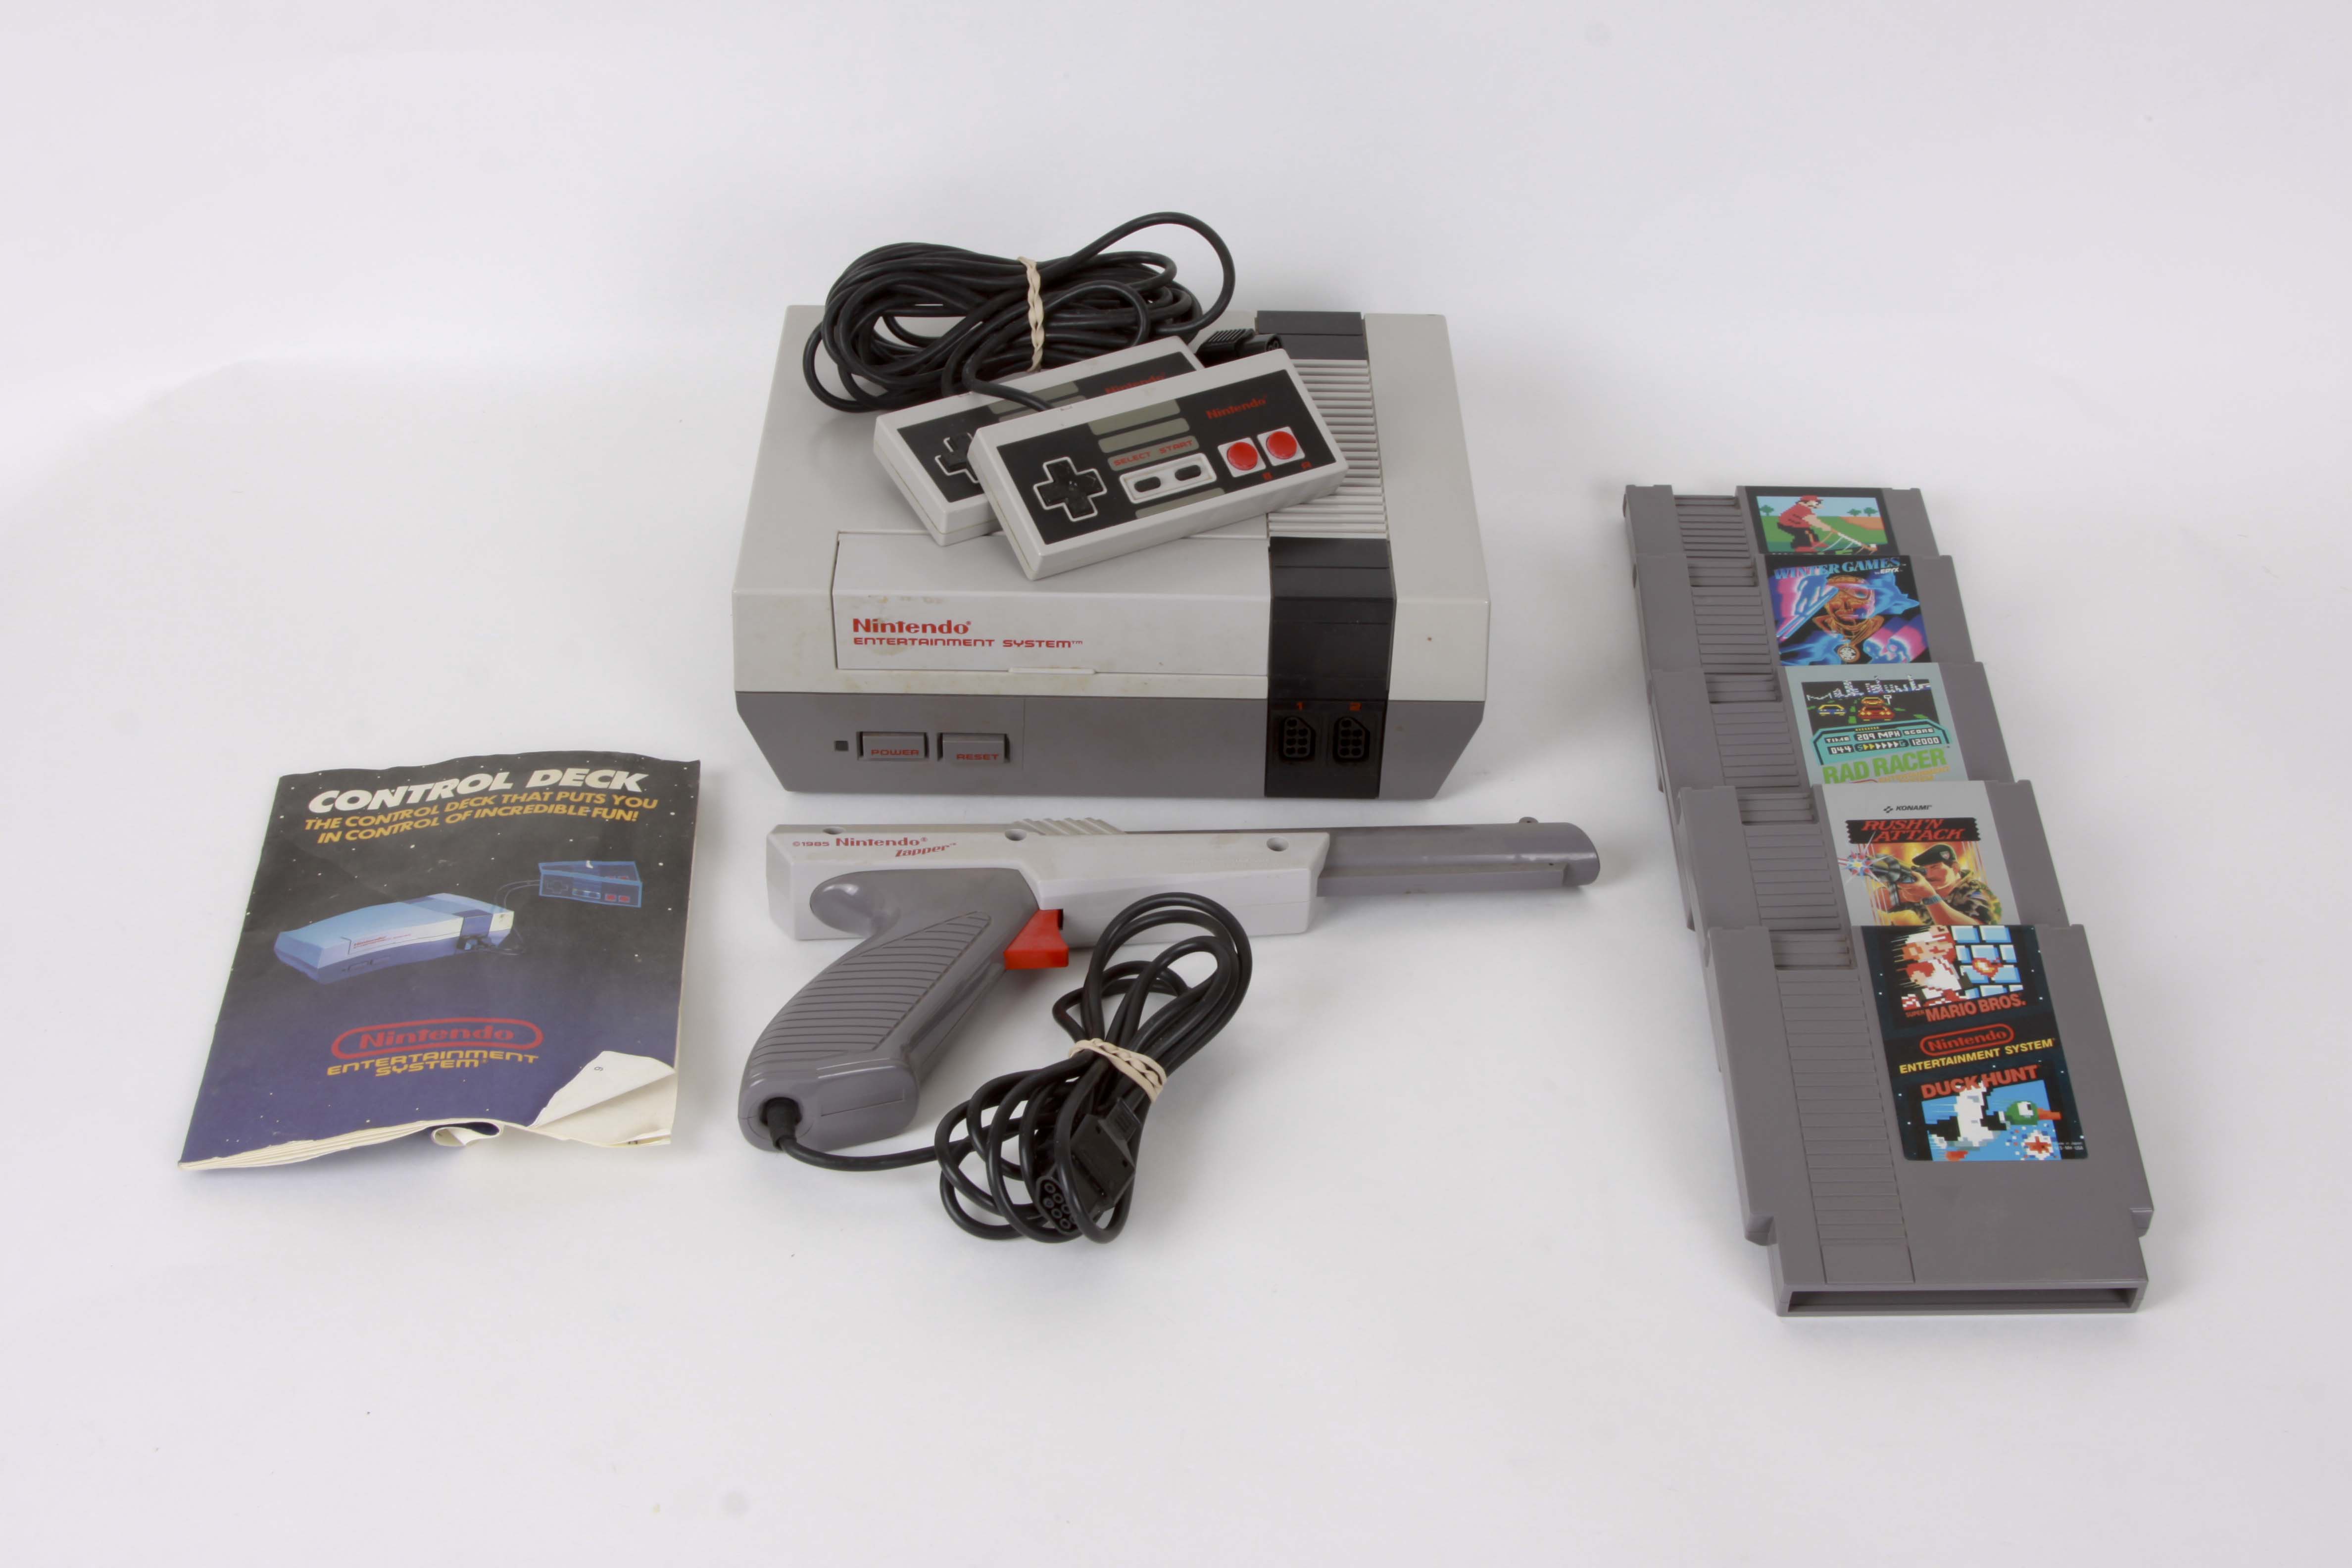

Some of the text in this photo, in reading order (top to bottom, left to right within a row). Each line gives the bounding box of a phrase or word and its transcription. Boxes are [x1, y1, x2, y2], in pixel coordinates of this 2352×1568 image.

[1114, 440, 1192, 466] SELECT START
[1774, 557, 1901, 580] WINTER GAMES
[853, 637, 995, 647] ENTERTAINMENT
[1831, 745, 1852, 754] 044
[1911, 736, 1940, 746] 12000
[1857, 733, 1876, 741] 209
[1877, 730, 1901, 738] MPH
[1821, 760, 1870, 784] RAD
[1872, 747, 1948, 777] RACER
[308, 768, 649, 814] CONTROL DECK
[305, 791, 659, 831] THE CONTROL DECK THAT PUTS YOU
[317, 803, 639, 844] IN CONTROL OF INCREDIBLE FUN!
[1861, 818, 1944, 831] RUSH'N
[1873, 828, 1966, 842] ATTACK
[1925, 1000, 1978, 1022] MARIO
[1978, 993, 2027, 1013] BROS.
[359, 1025, 515, 1050] Nintendo
[1927, 1030, 2008, 1052] Nintendo
[327, 1049, 539, 1076] ENTERTAINMENT
[1899, 1047, 2001, 1075] ENTERTAINMENT
[1920, 1064, 2039, 1099] DUCK HUNT
